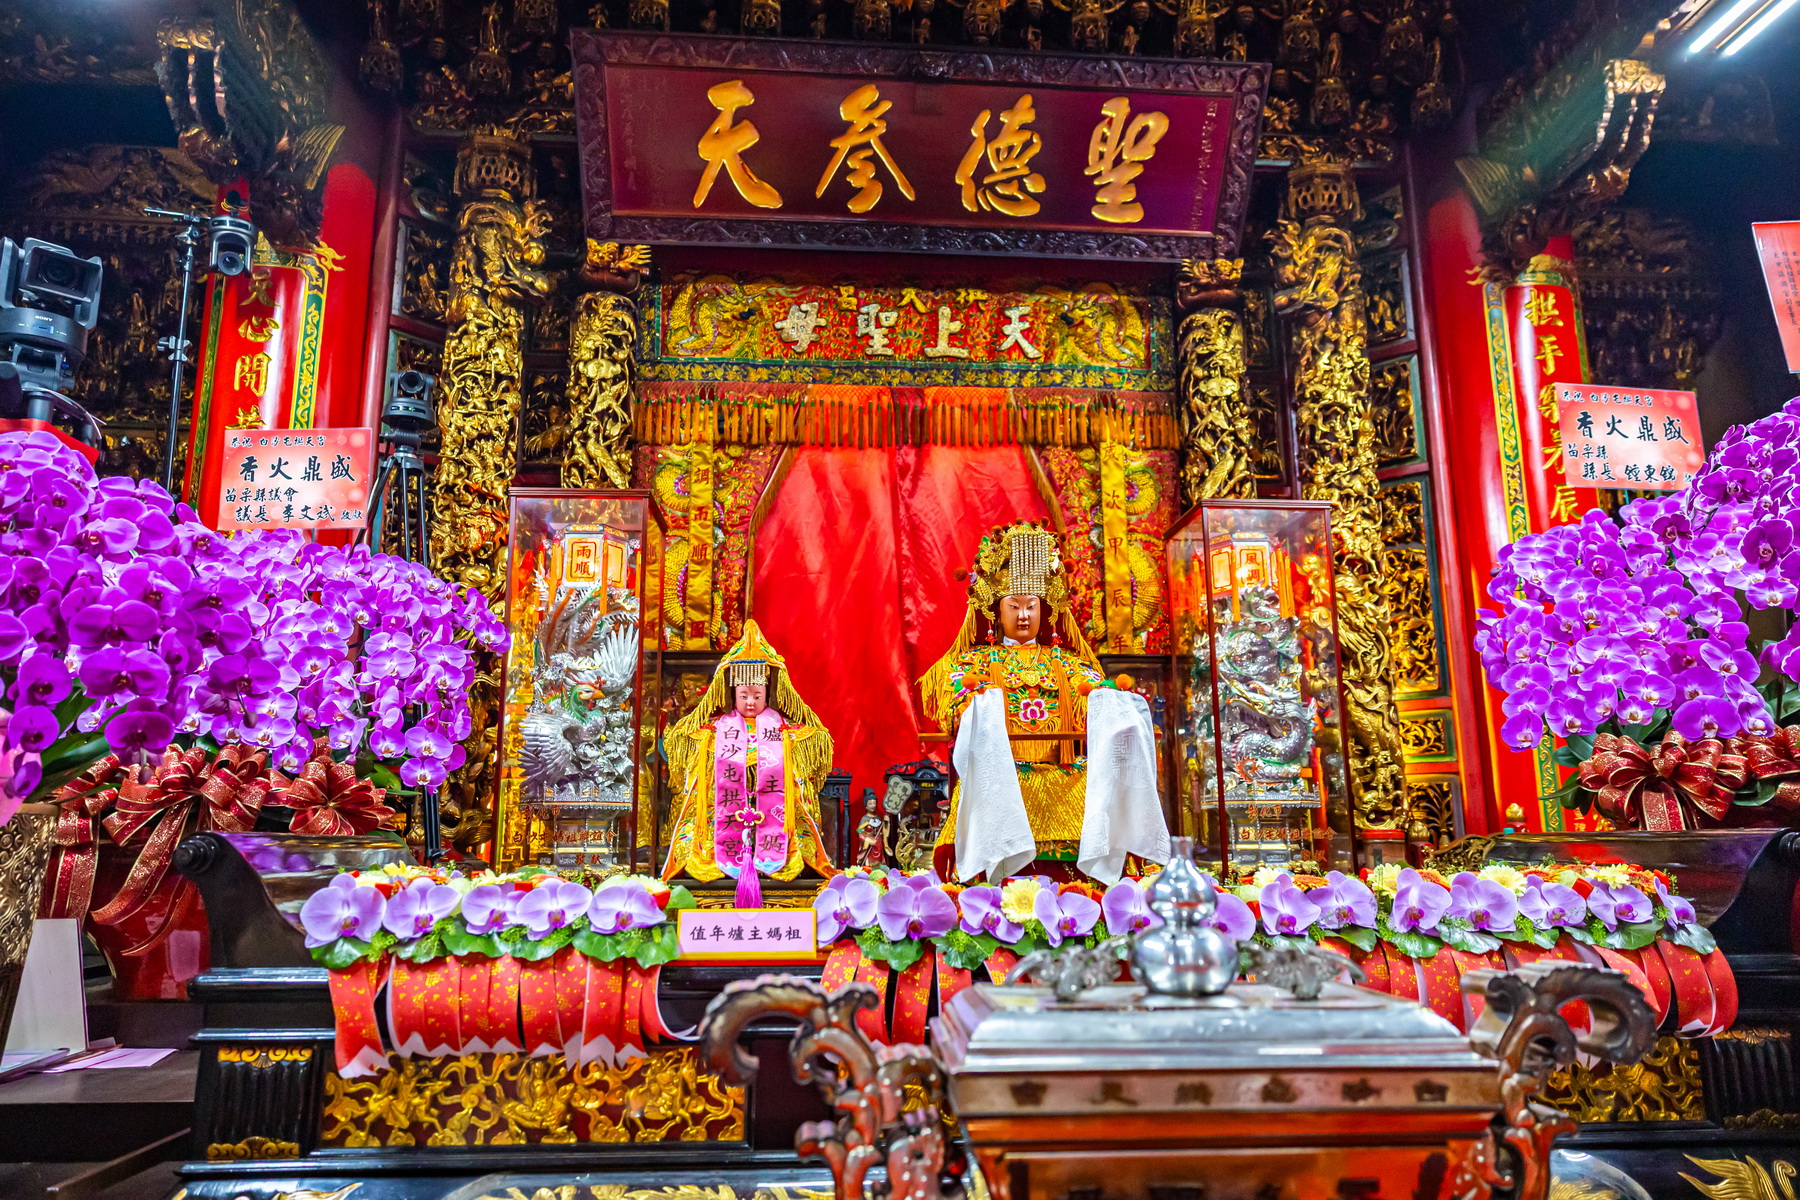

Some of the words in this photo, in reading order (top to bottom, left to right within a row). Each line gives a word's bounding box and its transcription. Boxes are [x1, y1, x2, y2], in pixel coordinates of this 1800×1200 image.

[774, 301, 1043, 360] 天上聖母
[1576, 411, 1690, 444] 香火鼎盛
[1567, 443, 1608, 460] 苗栗縣
[239, 454, 355, 482] 香火鼎盛
[1581, 462, 1616, 481] 縣長
[225, 487, 299, 502] 苗栗縣議會
[235, 504, 271, 523] 議長
[574, 545, 592, 576] 雨順
[720, 726, 743, 857] 白沙屯拱天宮
[761, 727, 784, 853] 爐主媽
[689, 925, 802, 941] 值年爐主媽祖
